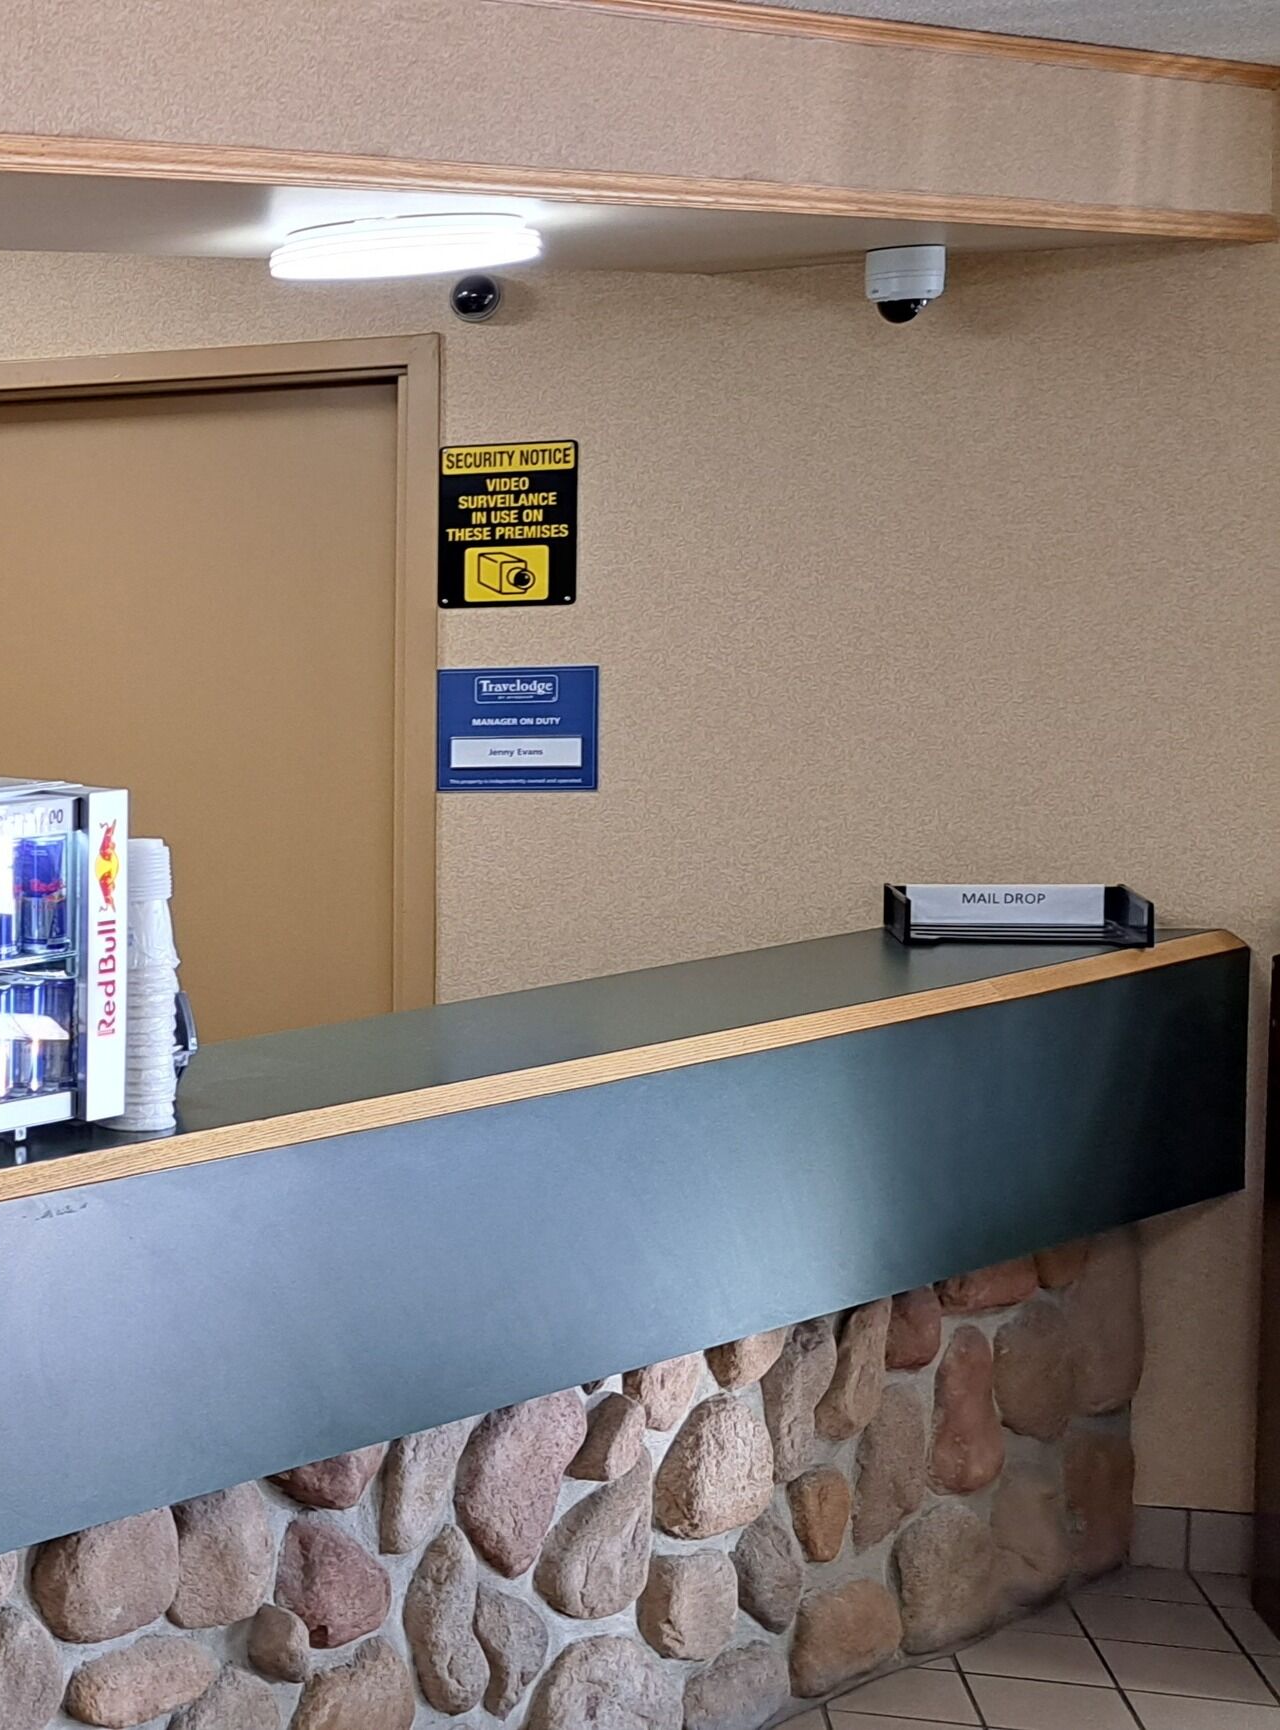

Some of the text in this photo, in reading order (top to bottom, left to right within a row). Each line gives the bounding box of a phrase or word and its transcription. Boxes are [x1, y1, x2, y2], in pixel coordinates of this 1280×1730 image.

[446, 447, 572, 470] SECURITY NOTICE
[486, 477, 530, 492] VIDEO
[458, 492, 558, 509] SURVEILANCE
[471, 509, 544, 525] IN USE ON
[446, 524, 569, 542] THESE PREMISES
[479, 679, 553, 695] Travelodge
[471, 717, 561, 726] MANAGER ON DUTY
[961, 892, 1046, 905] MAIL DROP
[97, 919, 117, 1037] Red Bull
